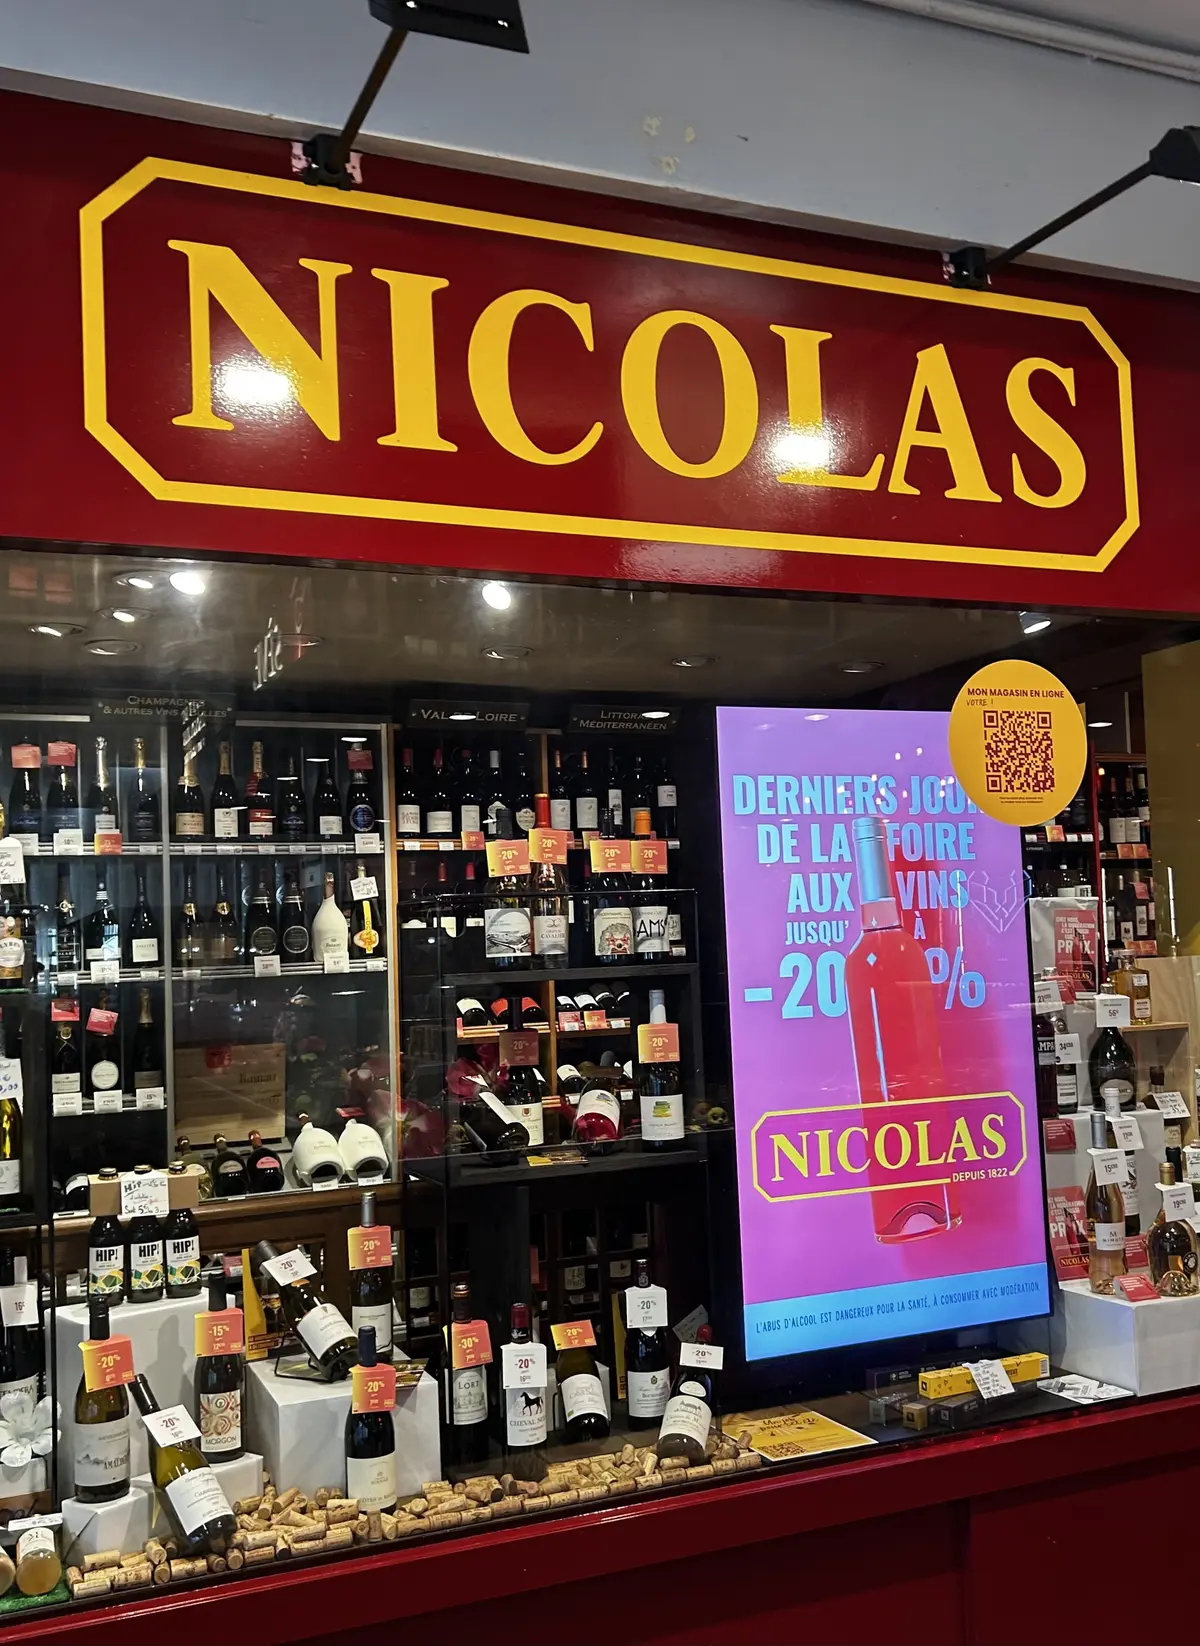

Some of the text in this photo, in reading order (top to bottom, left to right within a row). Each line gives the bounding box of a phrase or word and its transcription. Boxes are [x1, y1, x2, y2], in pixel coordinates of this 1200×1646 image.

[168, 239, 1087, 510] NICOLAS
[967, 688, 1065, 699] MON MAGASIN EN LIGNE
[103, 706, 112, 714] &
[114, 707, 153, 715] AUTRES
[156, 708, 179, 716] VINS
[421, 709, 449, 720] VAL
[475, 712, 517, 722] LOIRE
[601, 710, 647, 720] LITTORA
[733, 774, 985, 815] DERNIERS JOU
[539, 838, 558, 847] -20%
[757, 822, 976, 864] DE LA FOIRE
[498, 850, 518, 860] -20%
[601, 849, 621, 857] -20%
[640, 850, 658, 858] -20%
[787, 869, 969, 913] AUX VINS
[785, 911, 926, 946] JUSQU' À
[510, 1040, 529, 1050] -20%
[648, 1037, 668, 1047] -20%
[769, 1113, 1007, 1182] NICOLAS
[952, 1167, 1008, 1182] DEPUIS 1822
[139, 1243, 160, 1257] HIP!
[173, 1239, 194, 1254] HIP!
[360, 1240, 380, 1250] -20%
[96, 1248, 118, 1262] HIP!
[636, 1300, 657, 1310] -20%
[756, 1319, 781, 1333] L'ABUS
[784, 1315, 817, 1329] D'ALCOOL
[820, 1312, 832, 1323] EST
[836, 1305, 874, 1321] DANGEREUX
[877, 1302, 894, 1315] POUR
[897, 1302, 905, 1312] LA
[941, 1290, 979, 1305] CONSOMMER
[982, 1287, 998, 1299] AVEC
[1000, 1281, 1039, 1296] MODÉRATION
[208, 1325, 230, 1337] -15%
[563, 1328, 583, 1337] -20%
[458, 1337, 479, 1349] -30%
[97, 1354, 120, 1368] -20%
[514, 1358, 535, 1369] -20%
[364, 1380, 385, 1392] -20%
[160, 1416, 180, 1428] -20%
[510, 1418, 534, 1427] CHEVAL
[205, 1436, 236, 1445] MORGON
